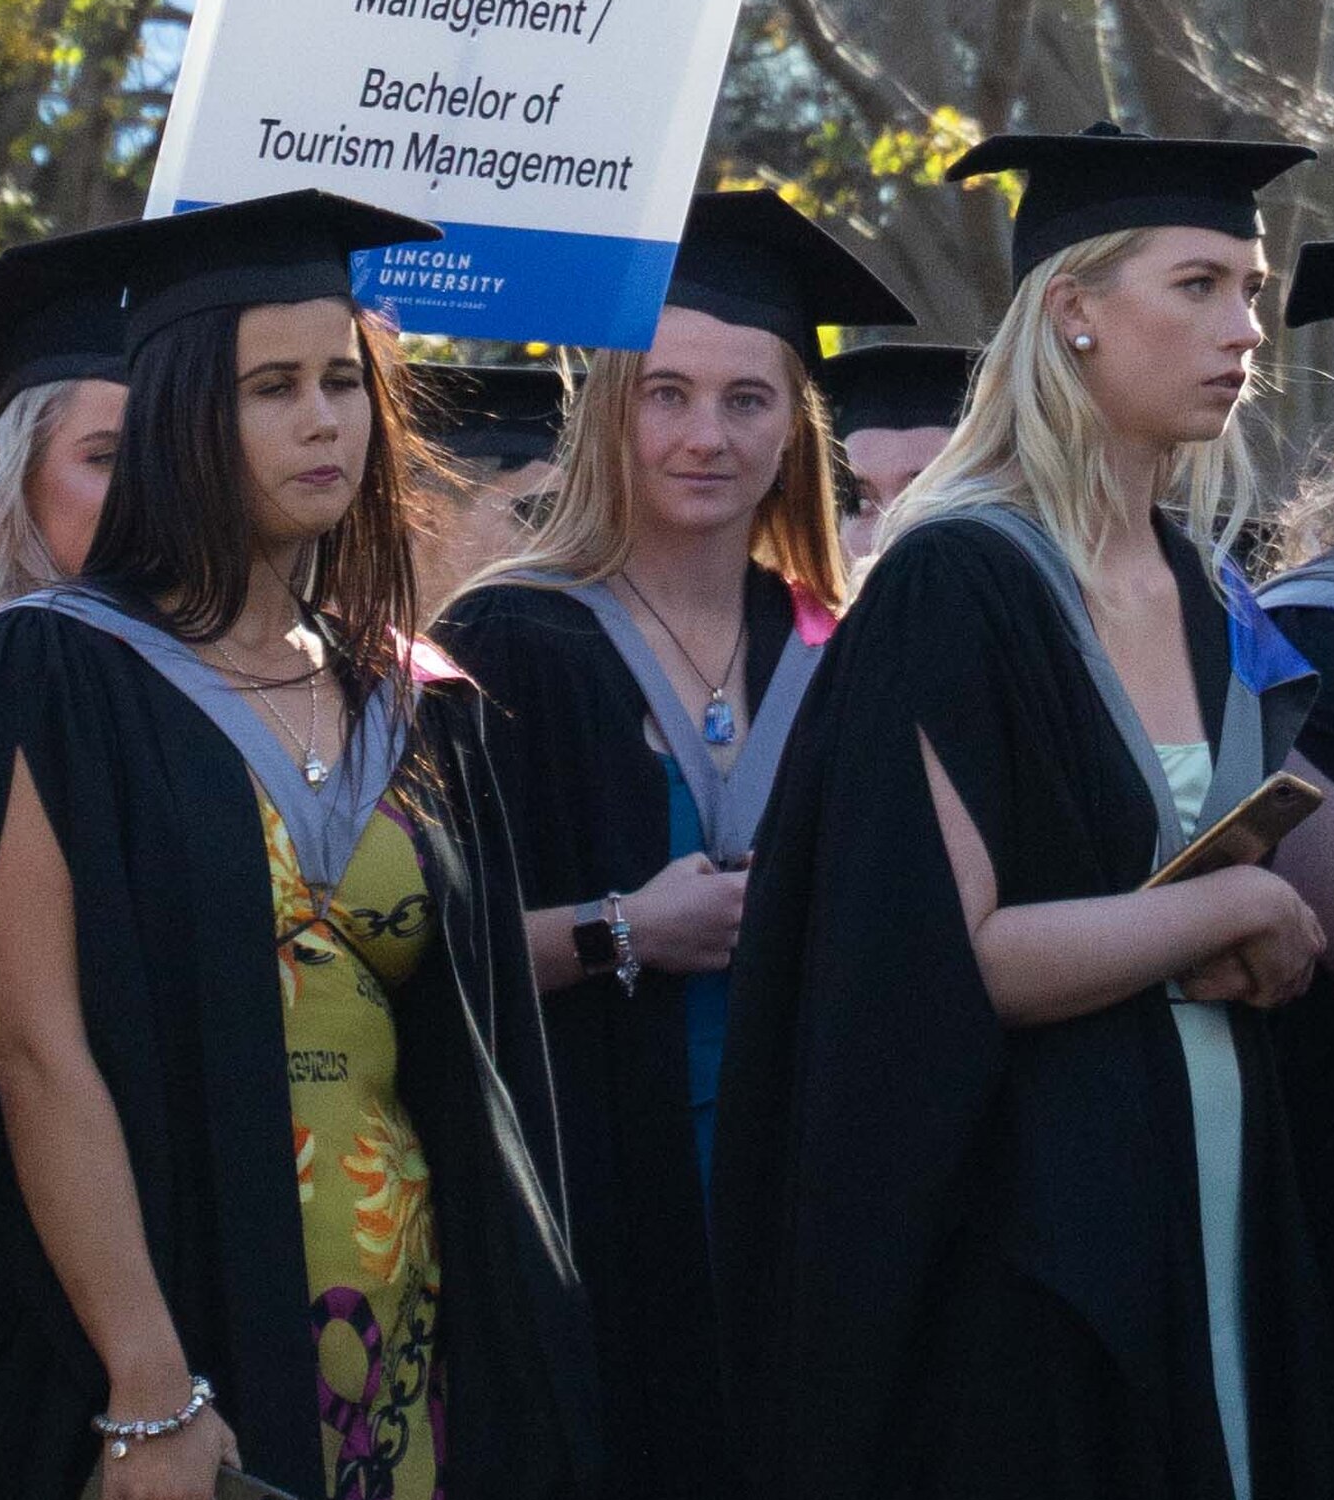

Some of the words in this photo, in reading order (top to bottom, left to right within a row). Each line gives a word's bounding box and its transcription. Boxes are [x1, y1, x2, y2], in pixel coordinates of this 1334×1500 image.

[359, 67, 519, 121] Bachelor
[522, 83, 565, 125] of
[258, 118, 395, 170] Tourism
[402, 131, 634, 192] Management
[383, 247, 472, 270] LINCOLN
[378, 269, 505, 294] UNIVERSITY
